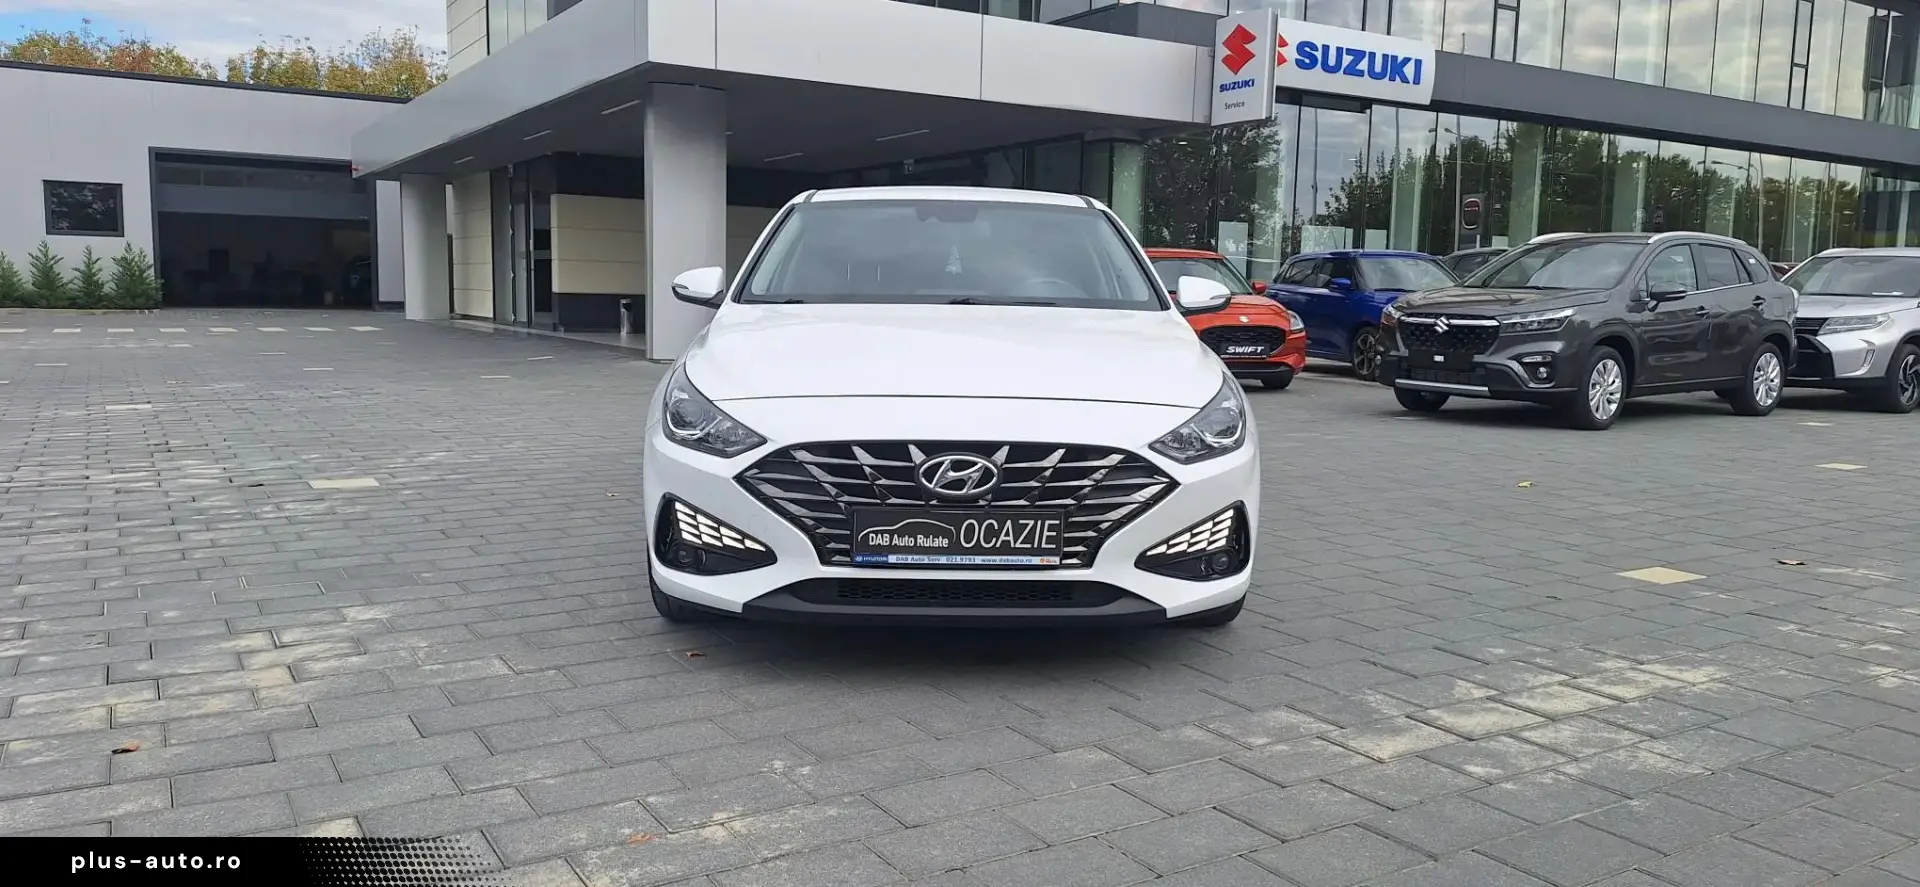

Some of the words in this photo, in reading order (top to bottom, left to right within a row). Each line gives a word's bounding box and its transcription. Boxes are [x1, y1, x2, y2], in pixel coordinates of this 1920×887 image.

[1295, 40, 1423, 86] SUZUKI
[1219, 78, 1255, 93] SUZUKI
[1224, 101, 1245, 110] Service
[869, 533, 890, 546] DAB
[892, 533, 915, 547] Auto
[917, 534, 949, 548] Rulate
[959, 518, 1061, 549] OCAZIE
